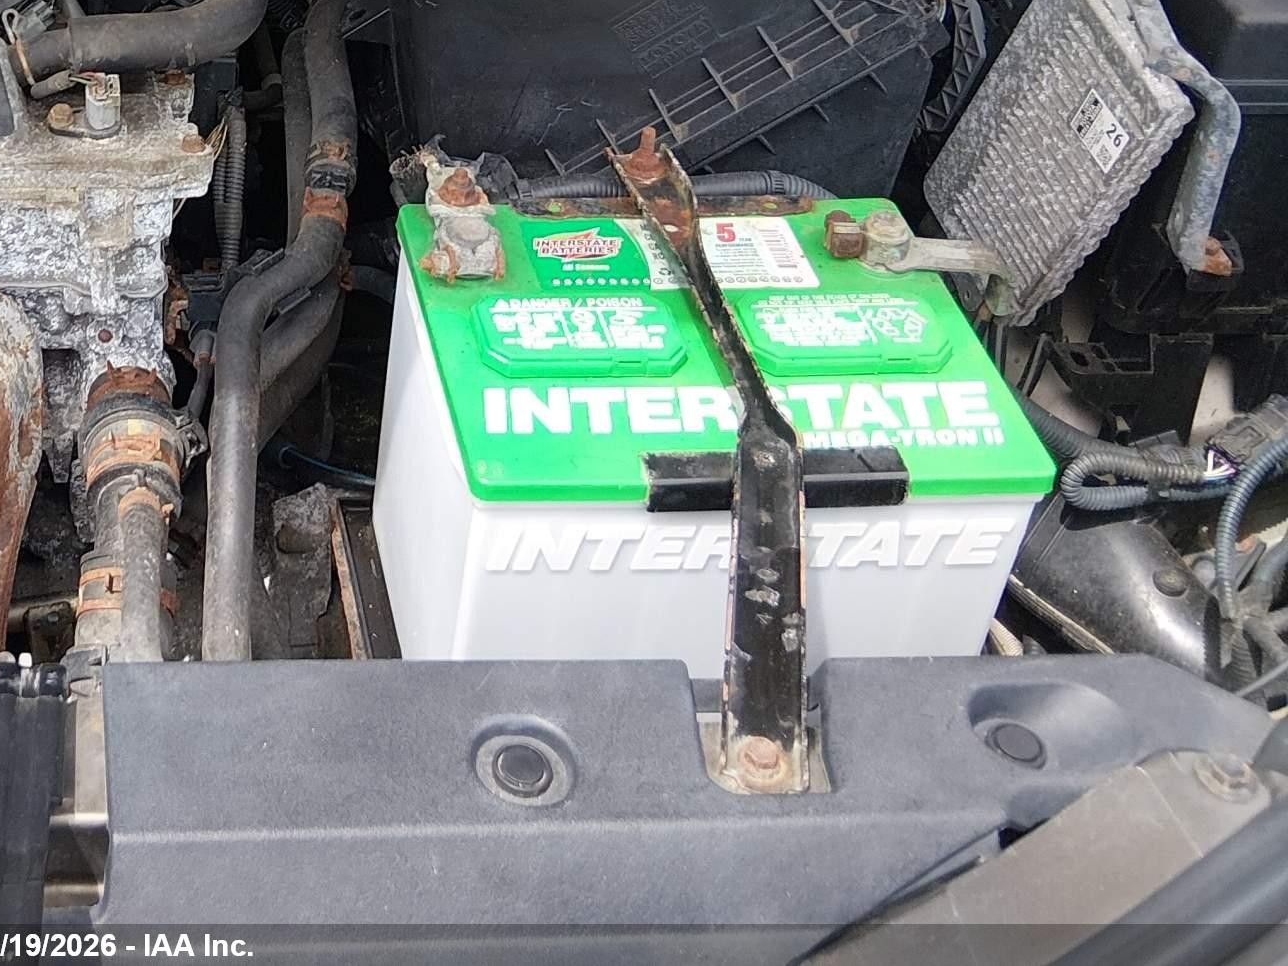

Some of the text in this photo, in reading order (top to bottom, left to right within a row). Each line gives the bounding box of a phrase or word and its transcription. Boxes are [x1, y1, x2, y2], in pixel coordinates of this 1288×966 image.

[1106, 122, 1124, 148] 26
[716, 222, 736, 242] 5
[535, 238, 618, 247] INTERSTATE
[541, 246, 615, 254] BATTERIES
[514, 298, 571, 308] DANGER
[586, 297, 643, 307] POISON
[485, 518, 1016, 571] INTERTATE
